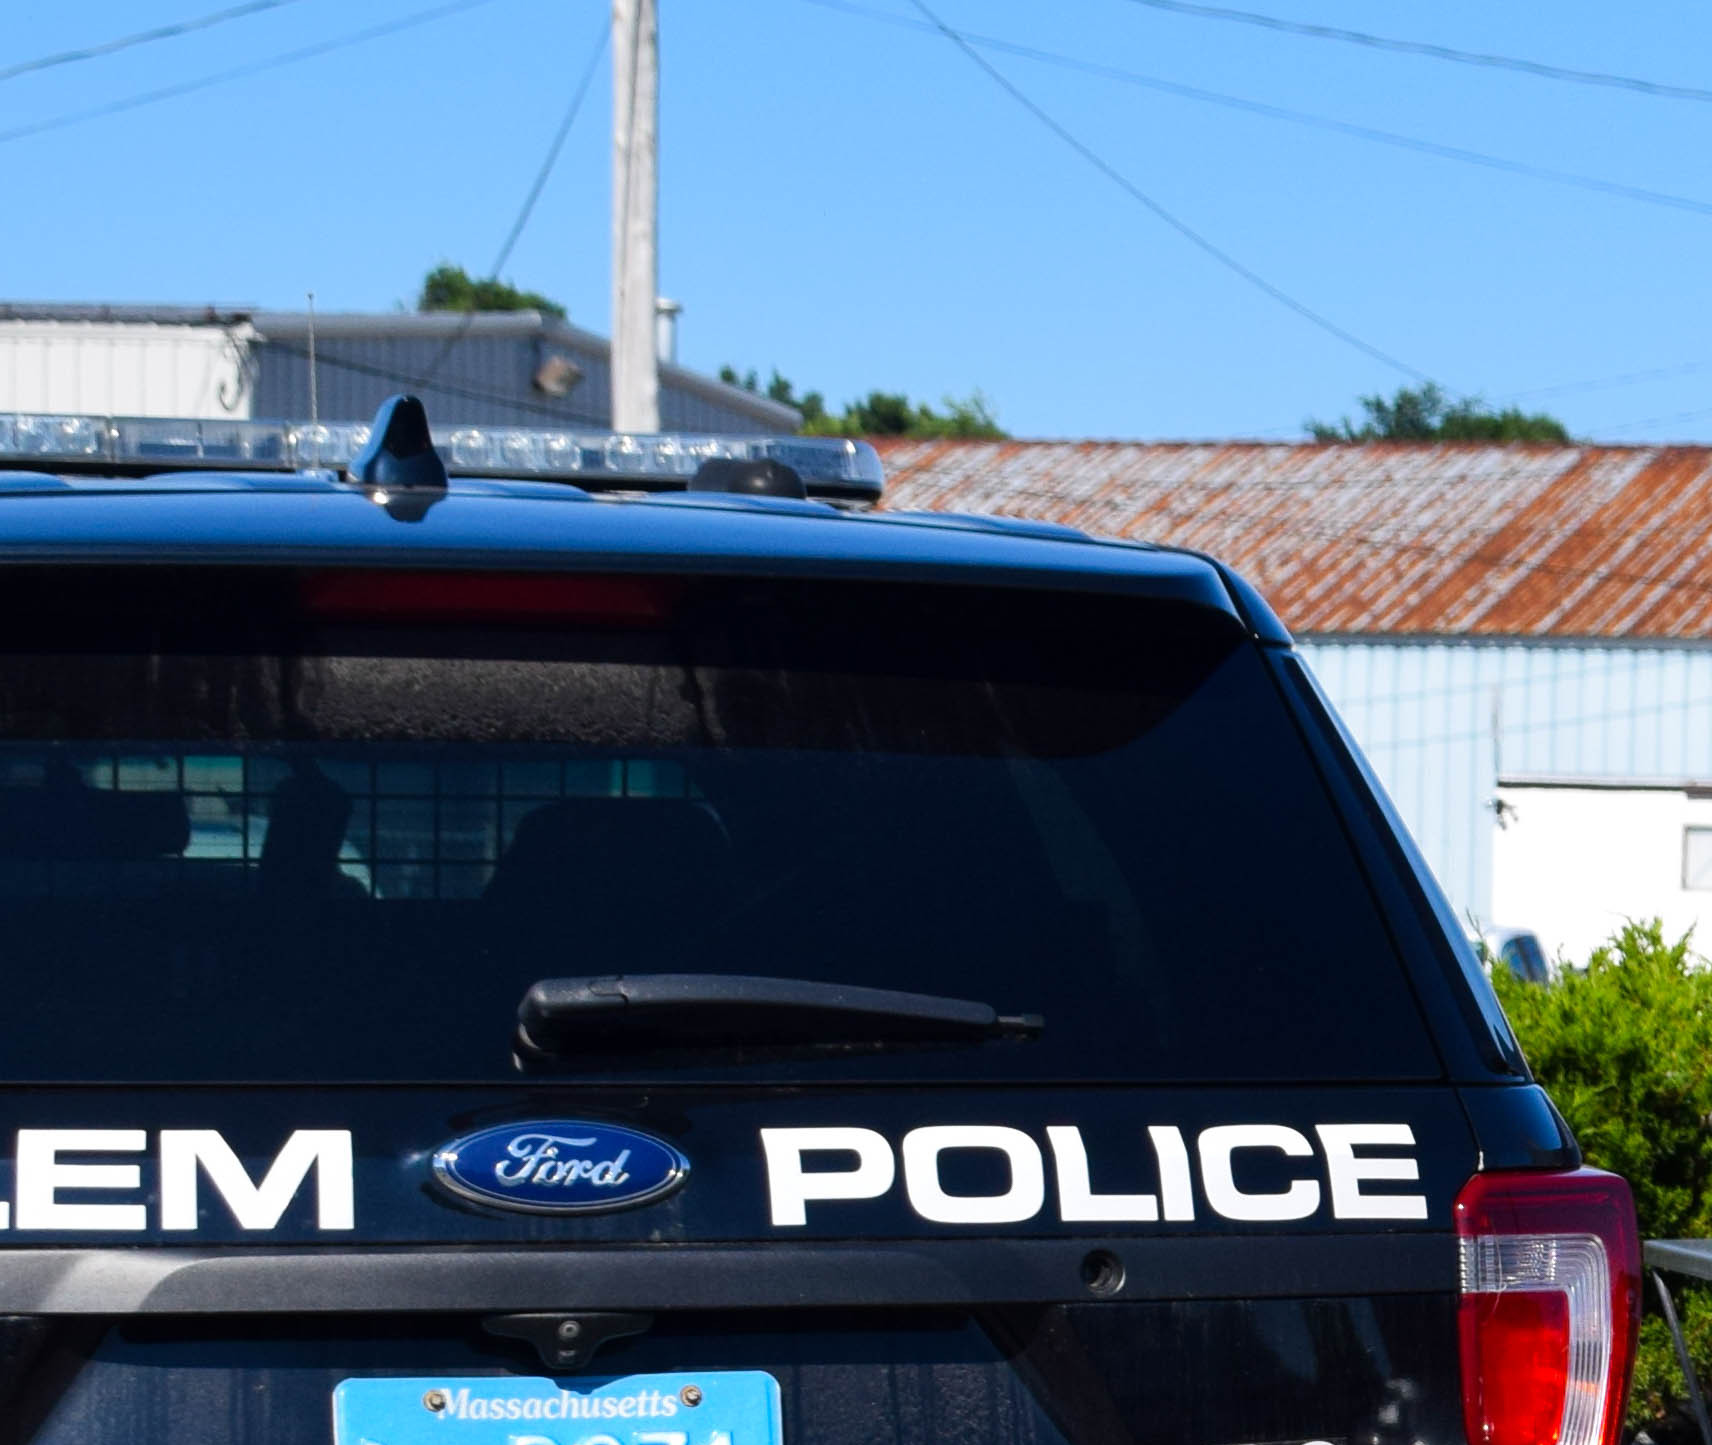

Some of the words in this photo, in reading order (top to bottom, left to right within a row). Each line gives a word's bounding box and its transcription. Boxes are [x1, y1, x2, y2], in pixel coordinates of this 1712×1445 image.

[0, 1129, 354, 1230] EM
[760, 1124, 1428, 1226] POLICE
[495, 1134, 630, 1189] Ford
[438, 1387, 678, 1421] Massachusetts
